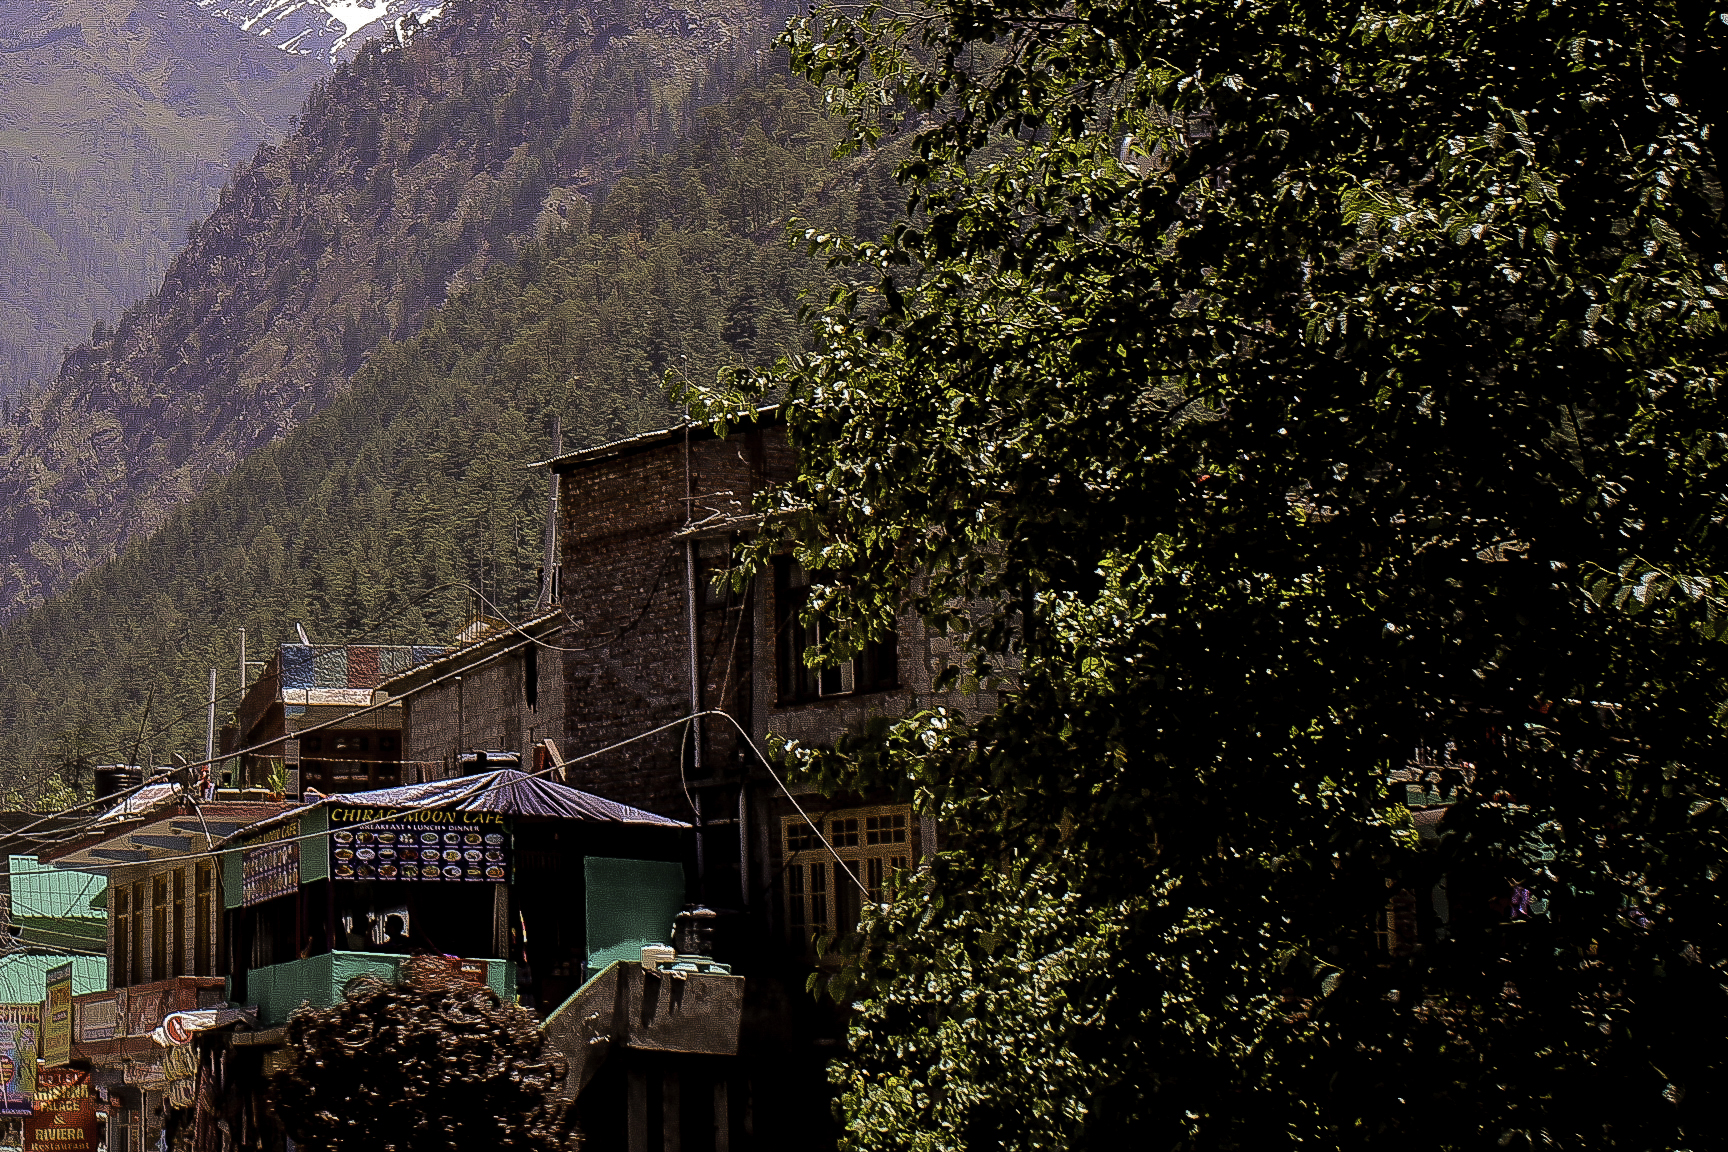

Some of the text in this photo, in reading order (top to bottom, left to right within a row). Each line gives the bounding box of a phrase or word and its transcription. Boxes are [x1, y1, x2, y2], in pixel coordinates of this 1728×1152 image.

[331, 808, 504, 824] CHIRAG MOON CAFE
[40, 1100, 80, 1111] PALACE
[35, 1128, 84, 1141] RIVIERA
[31, 1142, 90, 1151] Restaurant
